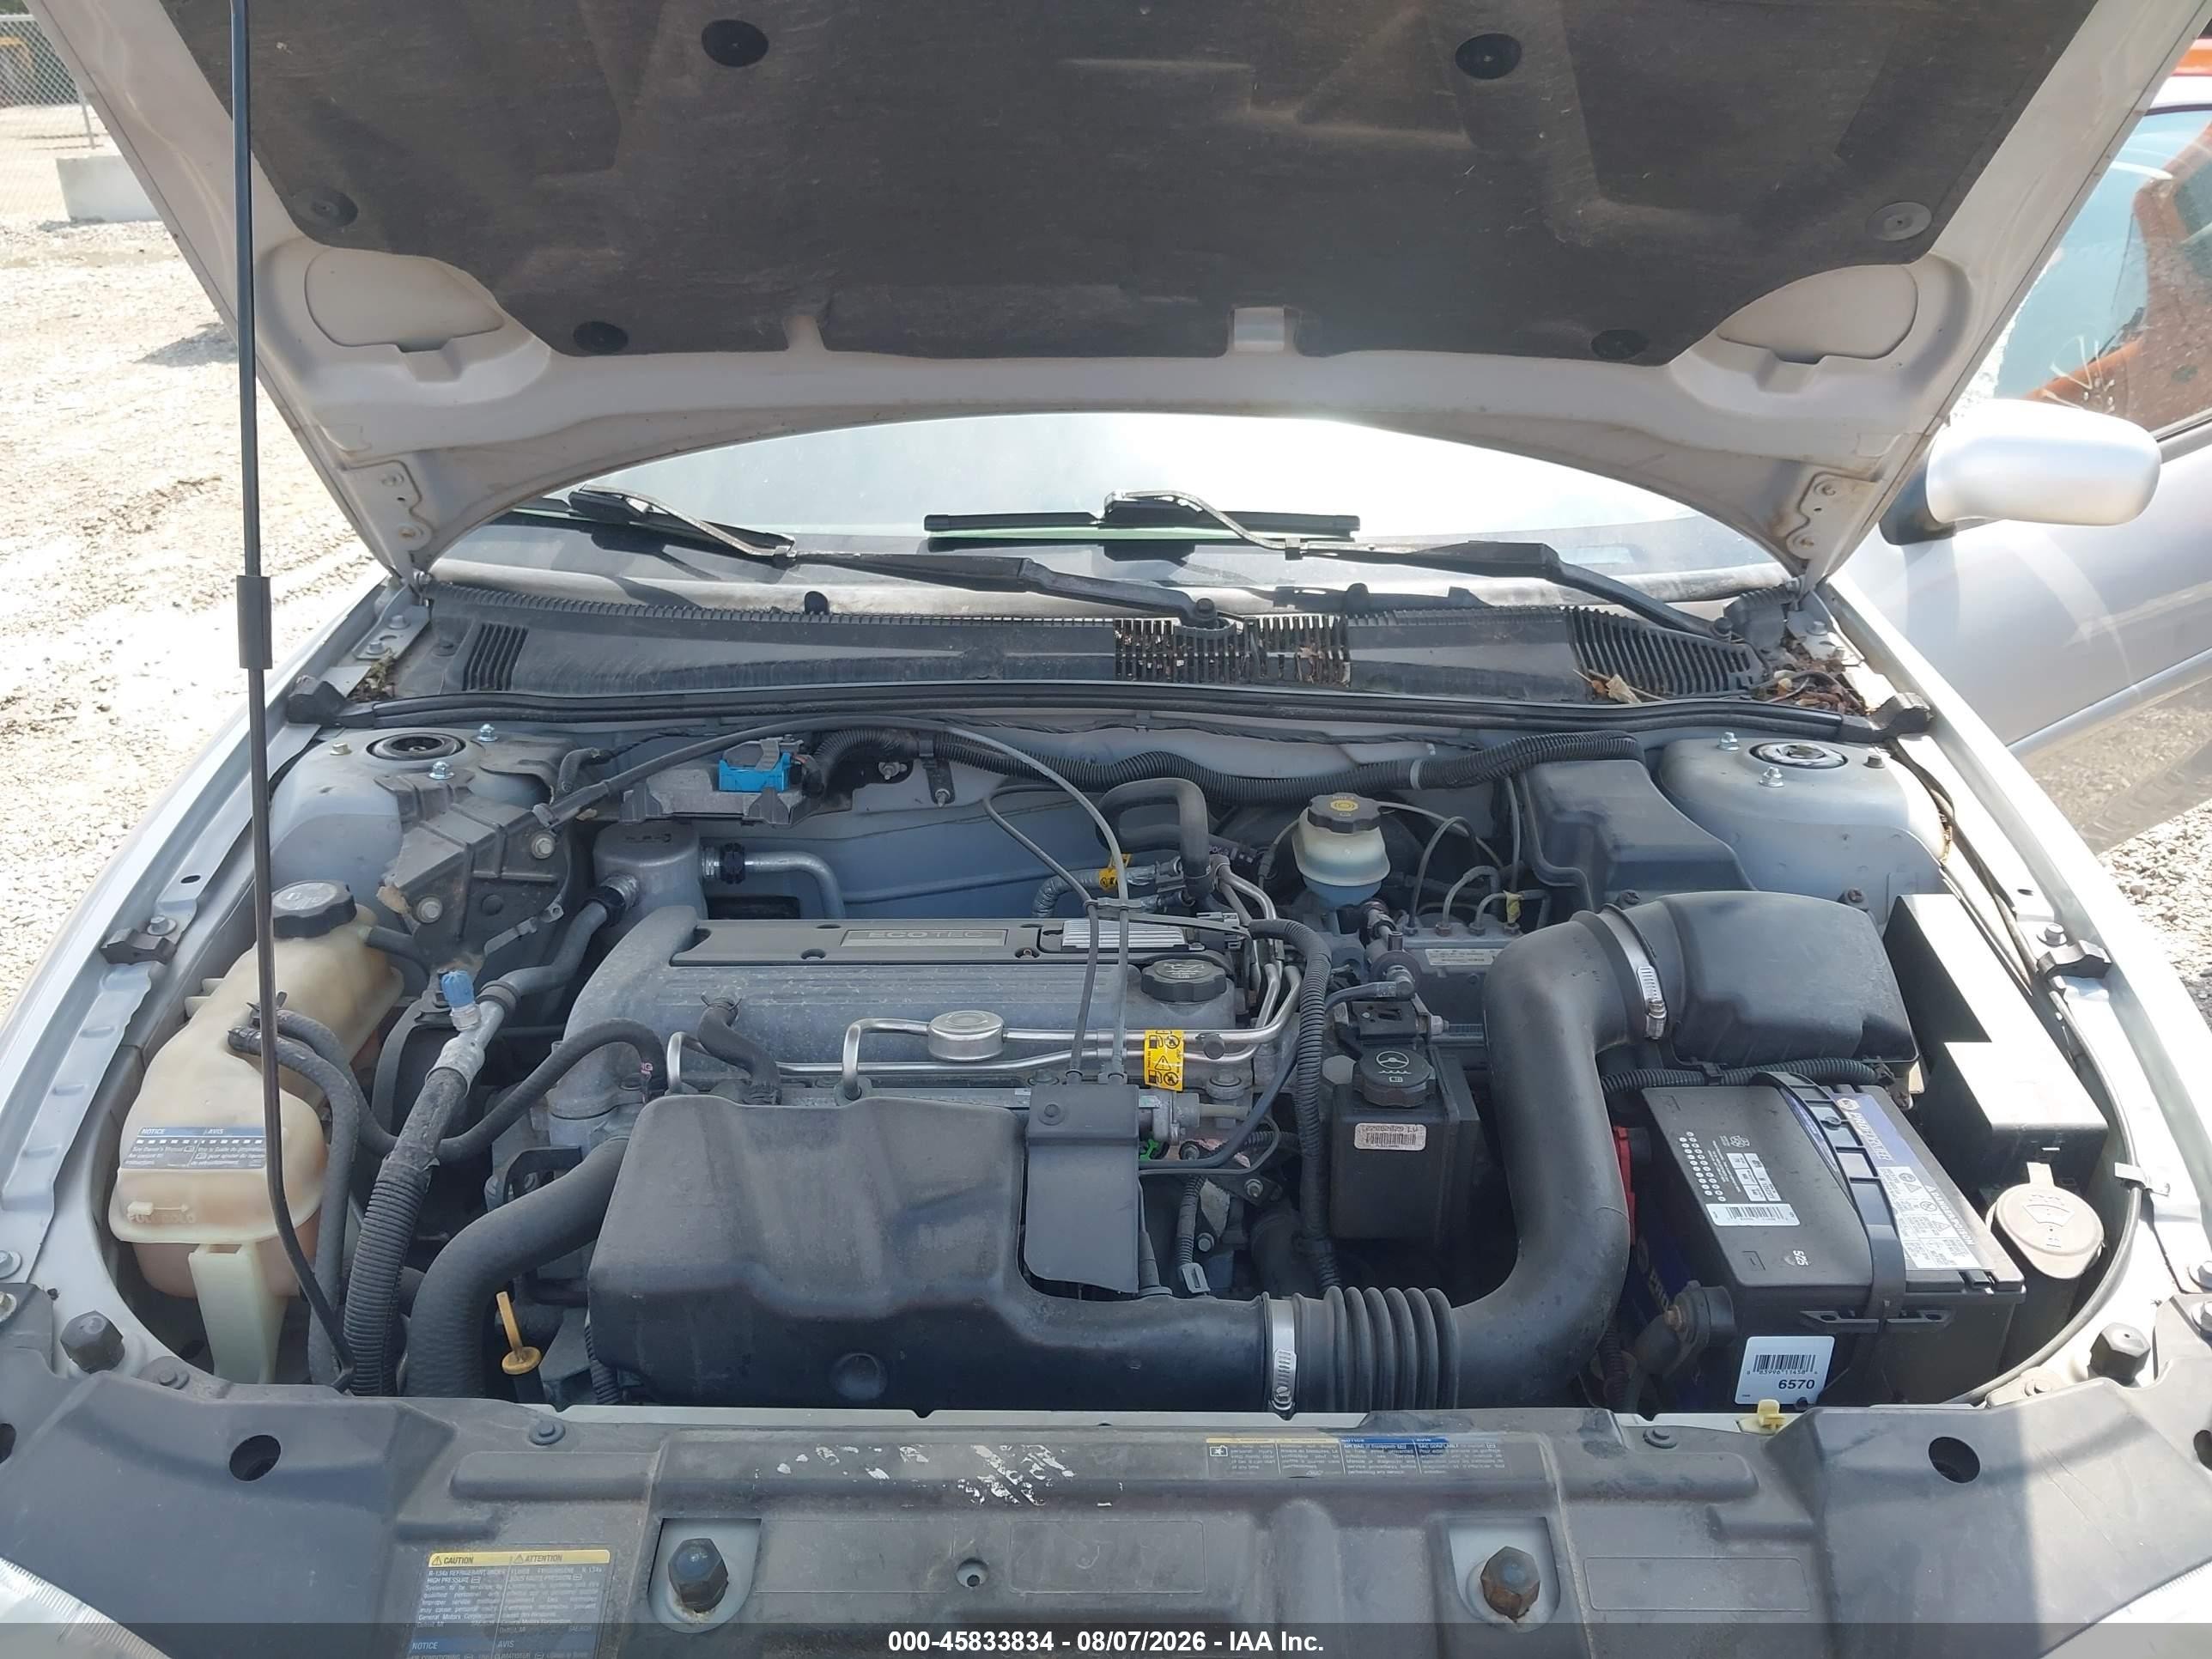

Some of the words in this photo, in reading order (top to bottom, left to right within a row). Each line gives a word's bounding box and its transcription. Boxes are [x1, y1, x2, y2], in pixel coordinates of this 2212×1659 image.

[1793, 1249, 1808, 1266] 525
[1778, 1379, 1815, 1389] 6570
[412, 1641, 439, 1650] NOTICE
